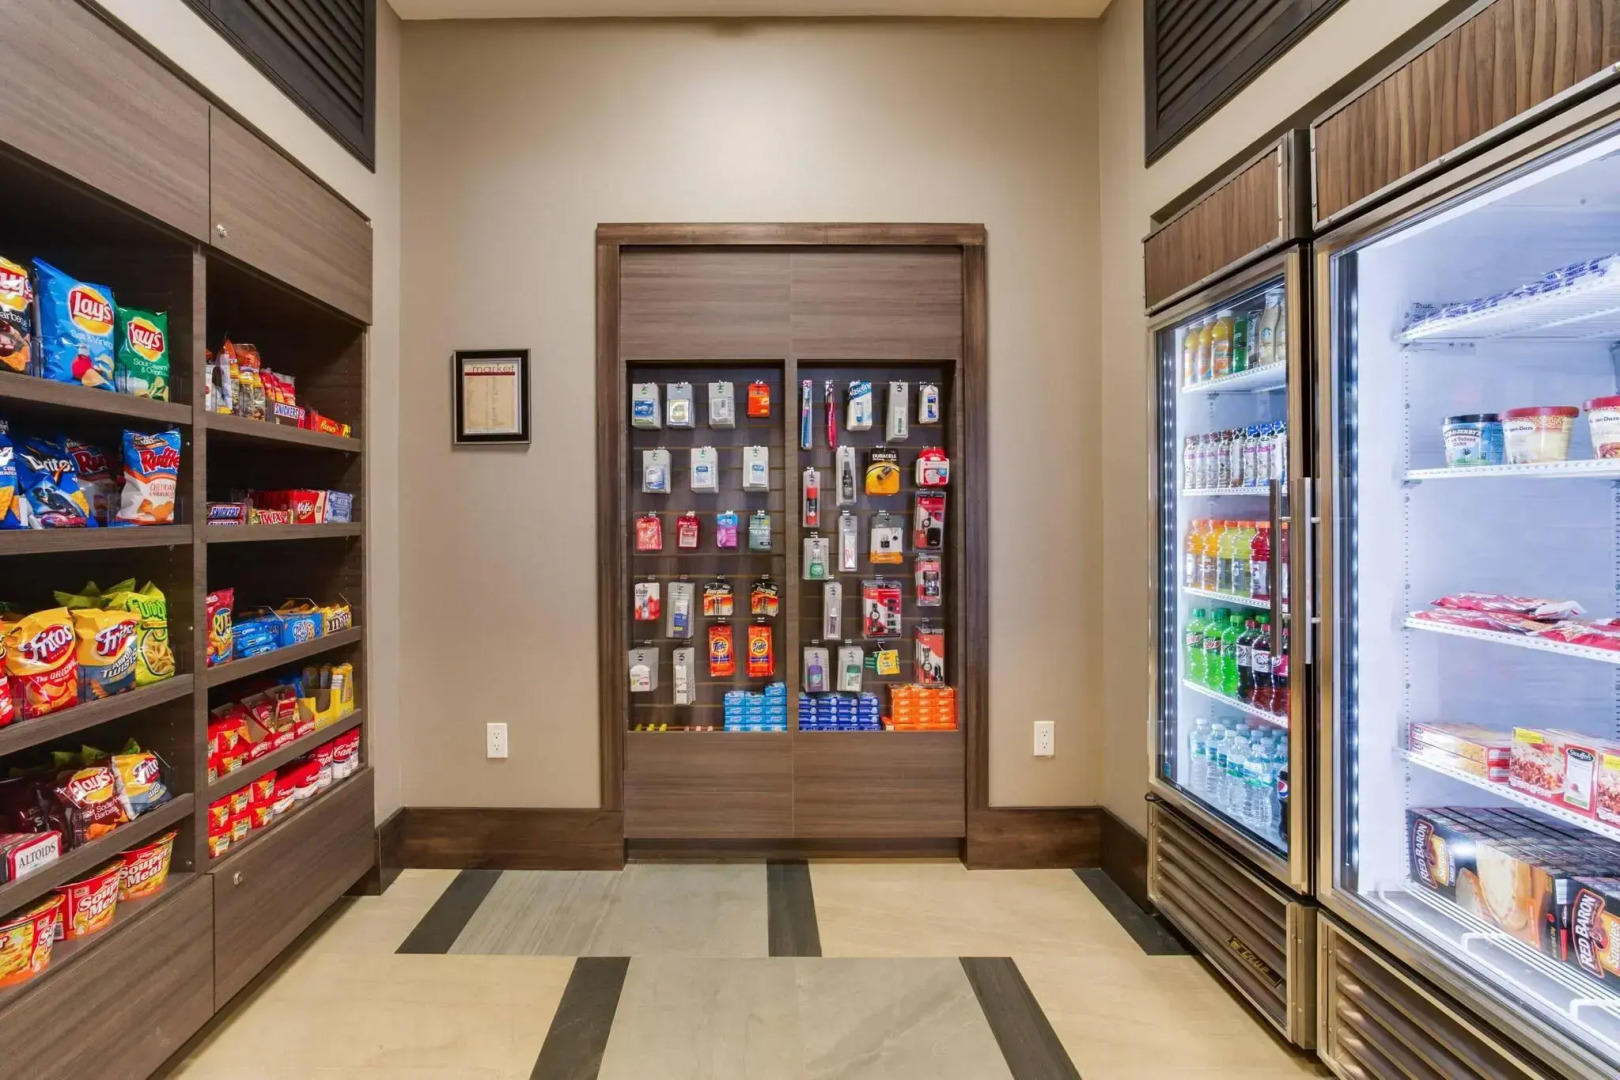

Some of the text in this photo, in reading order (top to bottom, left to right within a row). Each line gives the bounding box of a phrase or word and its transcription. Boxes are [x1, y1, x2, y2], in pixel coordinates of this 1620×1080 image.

[74, 292, 114, 322] Lay's
[130, 324, 162, 351] Lay's
[275, 402, 299, 419] SNICKERS
[139, 446, 180, 474] Ruffle
[211, 507, 239, 518] SNICKERS
[18, 625, 74, 662] Fritos
[713, 641, 727, 652] Tide
[35, 675, 48, 683] The
[18, 842, 56, 869] ALTOIDS
[119, 847, 168, 880] Souper
[1415, 823, 1430, 881] RED BARON
[127, 860, 163, 888] Meal
[79, 880, 119, 912] Soup
[1575, 894, 1598, 970] RED BARON
